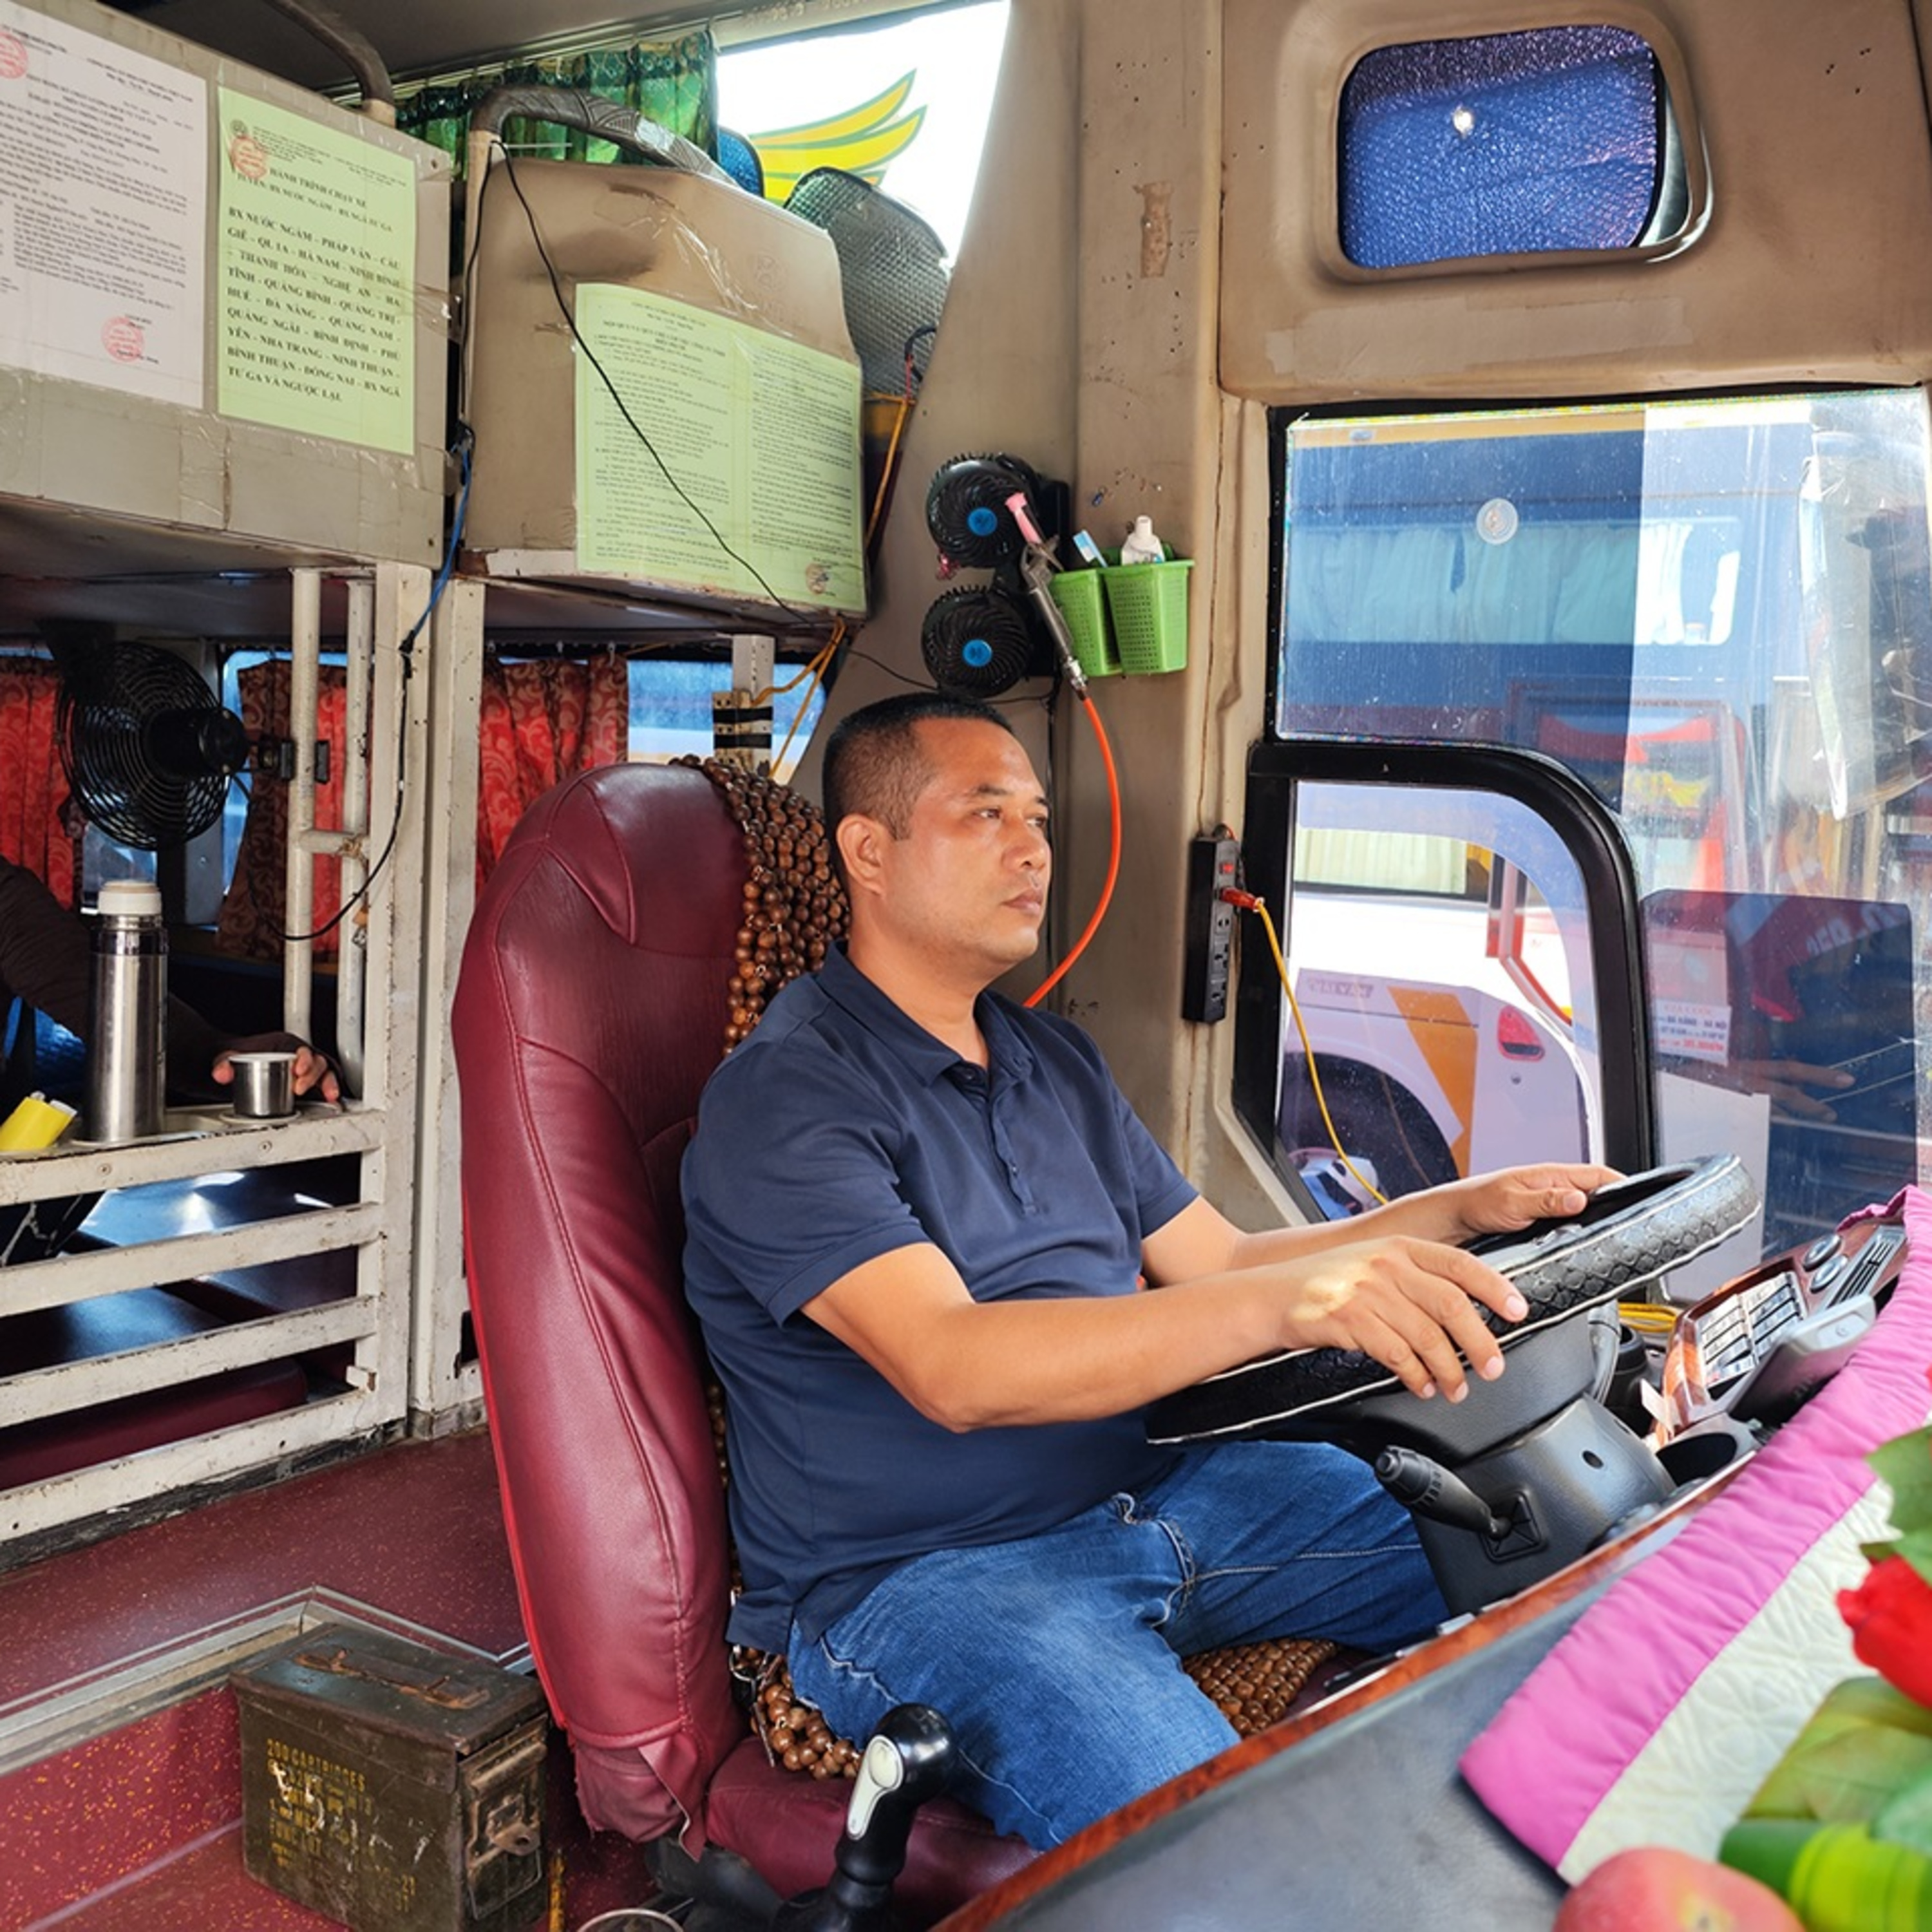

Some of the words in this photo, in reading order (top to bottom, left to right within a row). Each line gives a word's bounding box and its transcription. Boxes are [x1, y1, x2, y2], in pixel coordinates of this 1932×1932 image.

[229, 206, 244, 220] BX
[240, 249, 278, 270] THANH
[357, 287, 371, 297] AN
[316, 254, 339, 270] NAM
[349, 265, 374, 281] NINH
[370, 327, 393, 341] NAM
[228, 326, 251, 339] YÊN
[260, 335, 283, 349] NHA
[287, 341, 323, 359] TRANG
[332, 353, 357, 368] NINH
[245, 371, 262, 383] GA
[336, 374, 355, 386] NAI
[364, 380, 377, 392] BX
